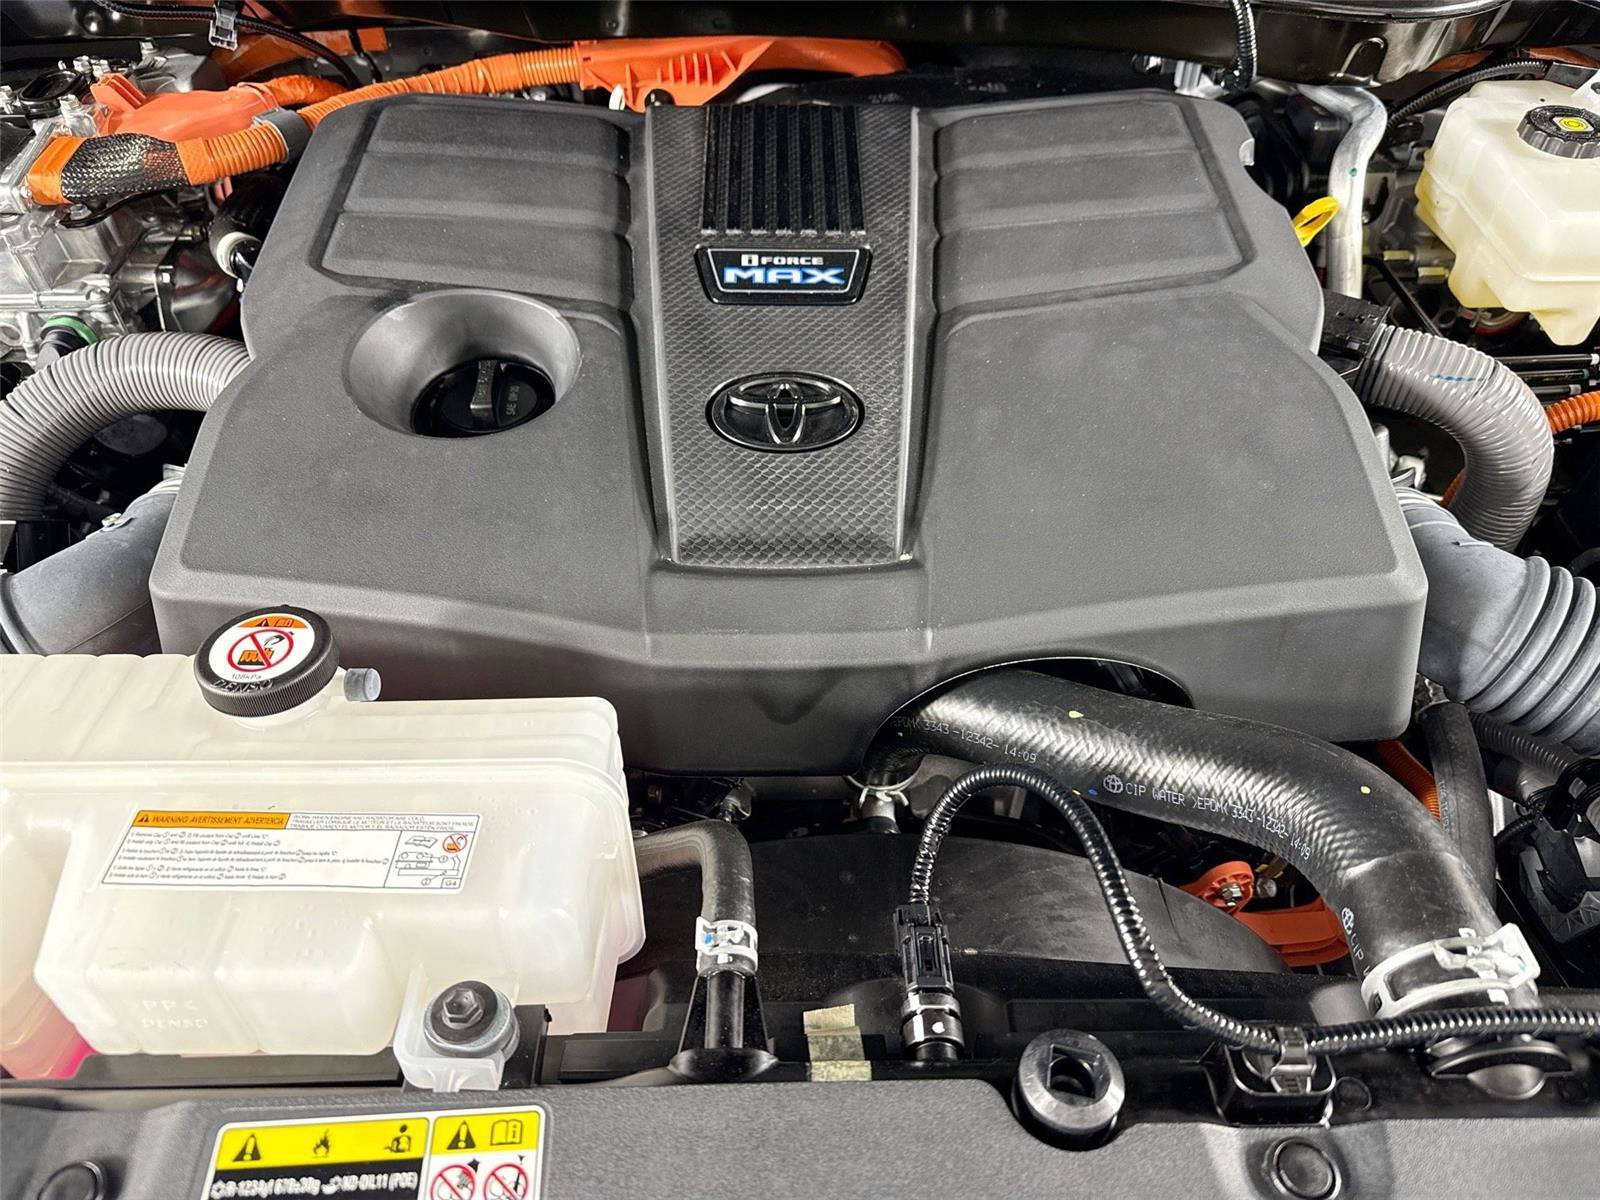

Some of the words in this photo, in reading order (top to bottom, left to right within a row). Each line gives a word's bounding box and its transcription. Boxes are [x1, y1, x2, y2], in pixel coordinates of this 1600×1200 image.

[723, 267, 845, 285] MAX
[923, 719, 949, 735] 3343
[1004, 744, 1037, 764] 14:09
[1125, 782, 1147, 797] CIP
[1152, 788, 1186, 807] WATER
[152, 815, 190, 824] WARNING
[191, 815, 243, 825] AVERTISSEMENT
